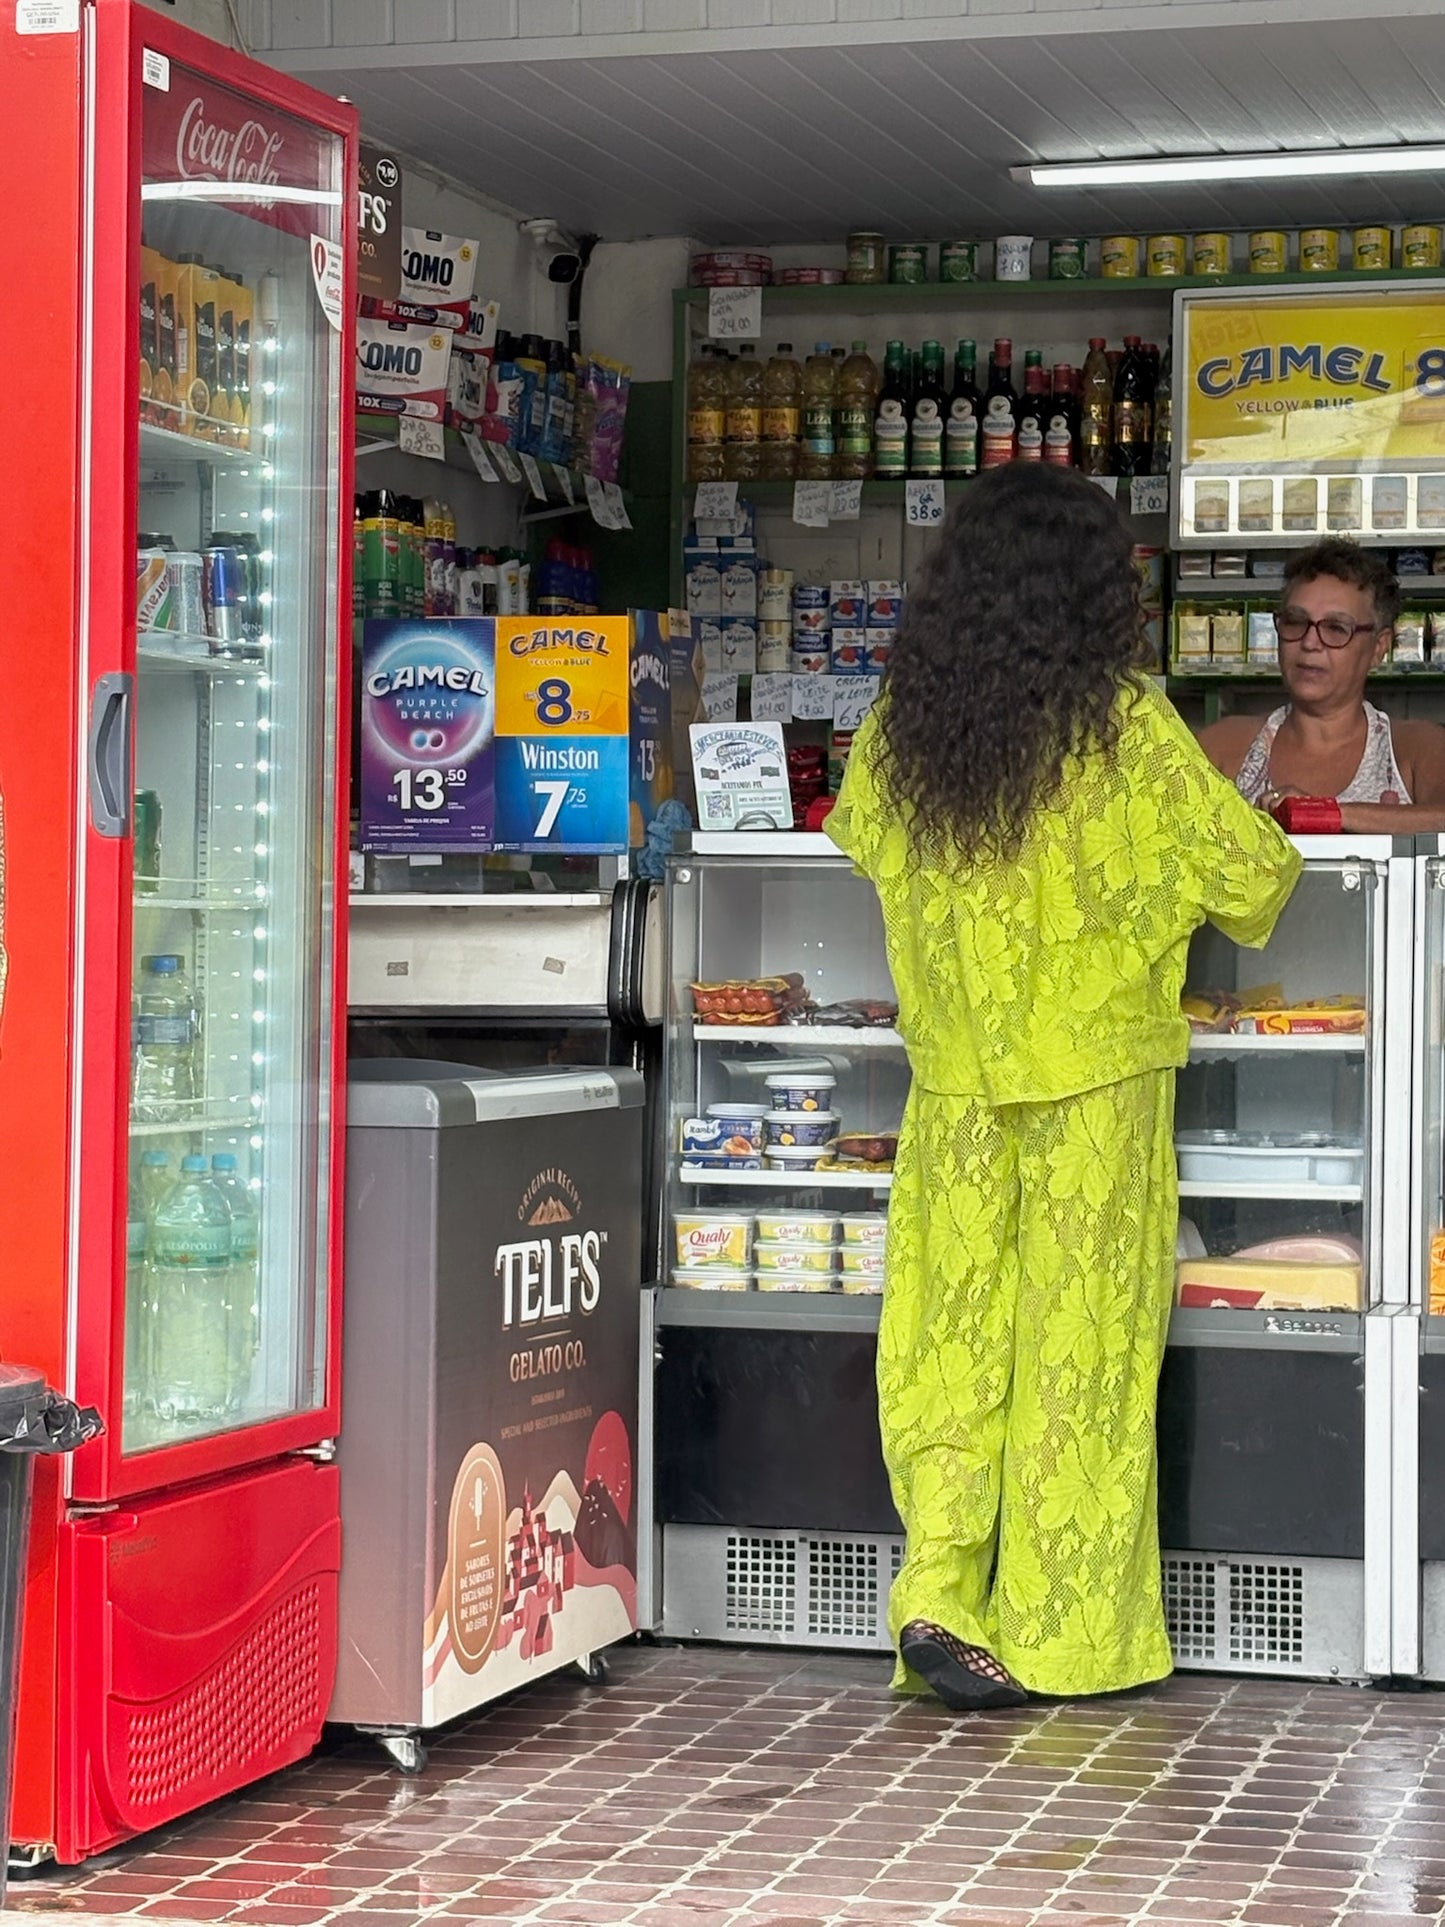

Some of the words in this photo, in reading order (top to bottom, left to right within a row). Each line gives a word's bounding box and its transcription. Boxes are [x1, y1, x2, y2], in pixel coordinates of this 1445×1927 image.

[177, 97, 284, 210] Coca-Cola
[407, 251, 454, 287] OMO
[398, 304, 418, 320] 10X
[366, 342, 422, 375] OMO
[1196, 343, 1392, 399] CAMEL
[358, 396, 382, 410] 10X
[1235, 400, 1301, 415] YELLOW
[1312, 398, 1355, 411] BLUE
[804, 411, 832, 425] Liza
[841, 411, 867, 425] Liza
[510, 628, 610, 657] CAMEL
[569, 658, 592, 667] BLUE
[367, 664, 490, 699] CAMEL
[395, 699, 460, 708] PURPLE
[400, 710, 455, 720] BEACH
[521, 741, 600, 770] Winston
[517, 1167, 556, 1221] ORIGINAL
[555, 1167, 583, 1214] RECIPE
[689, 1228, 731, 1250] Qualy
[495, 1230, 601, 1328] TELFS
[510, 1344, 563, 1383] GELATO
[564, 1339, 587, 1371] CO.
